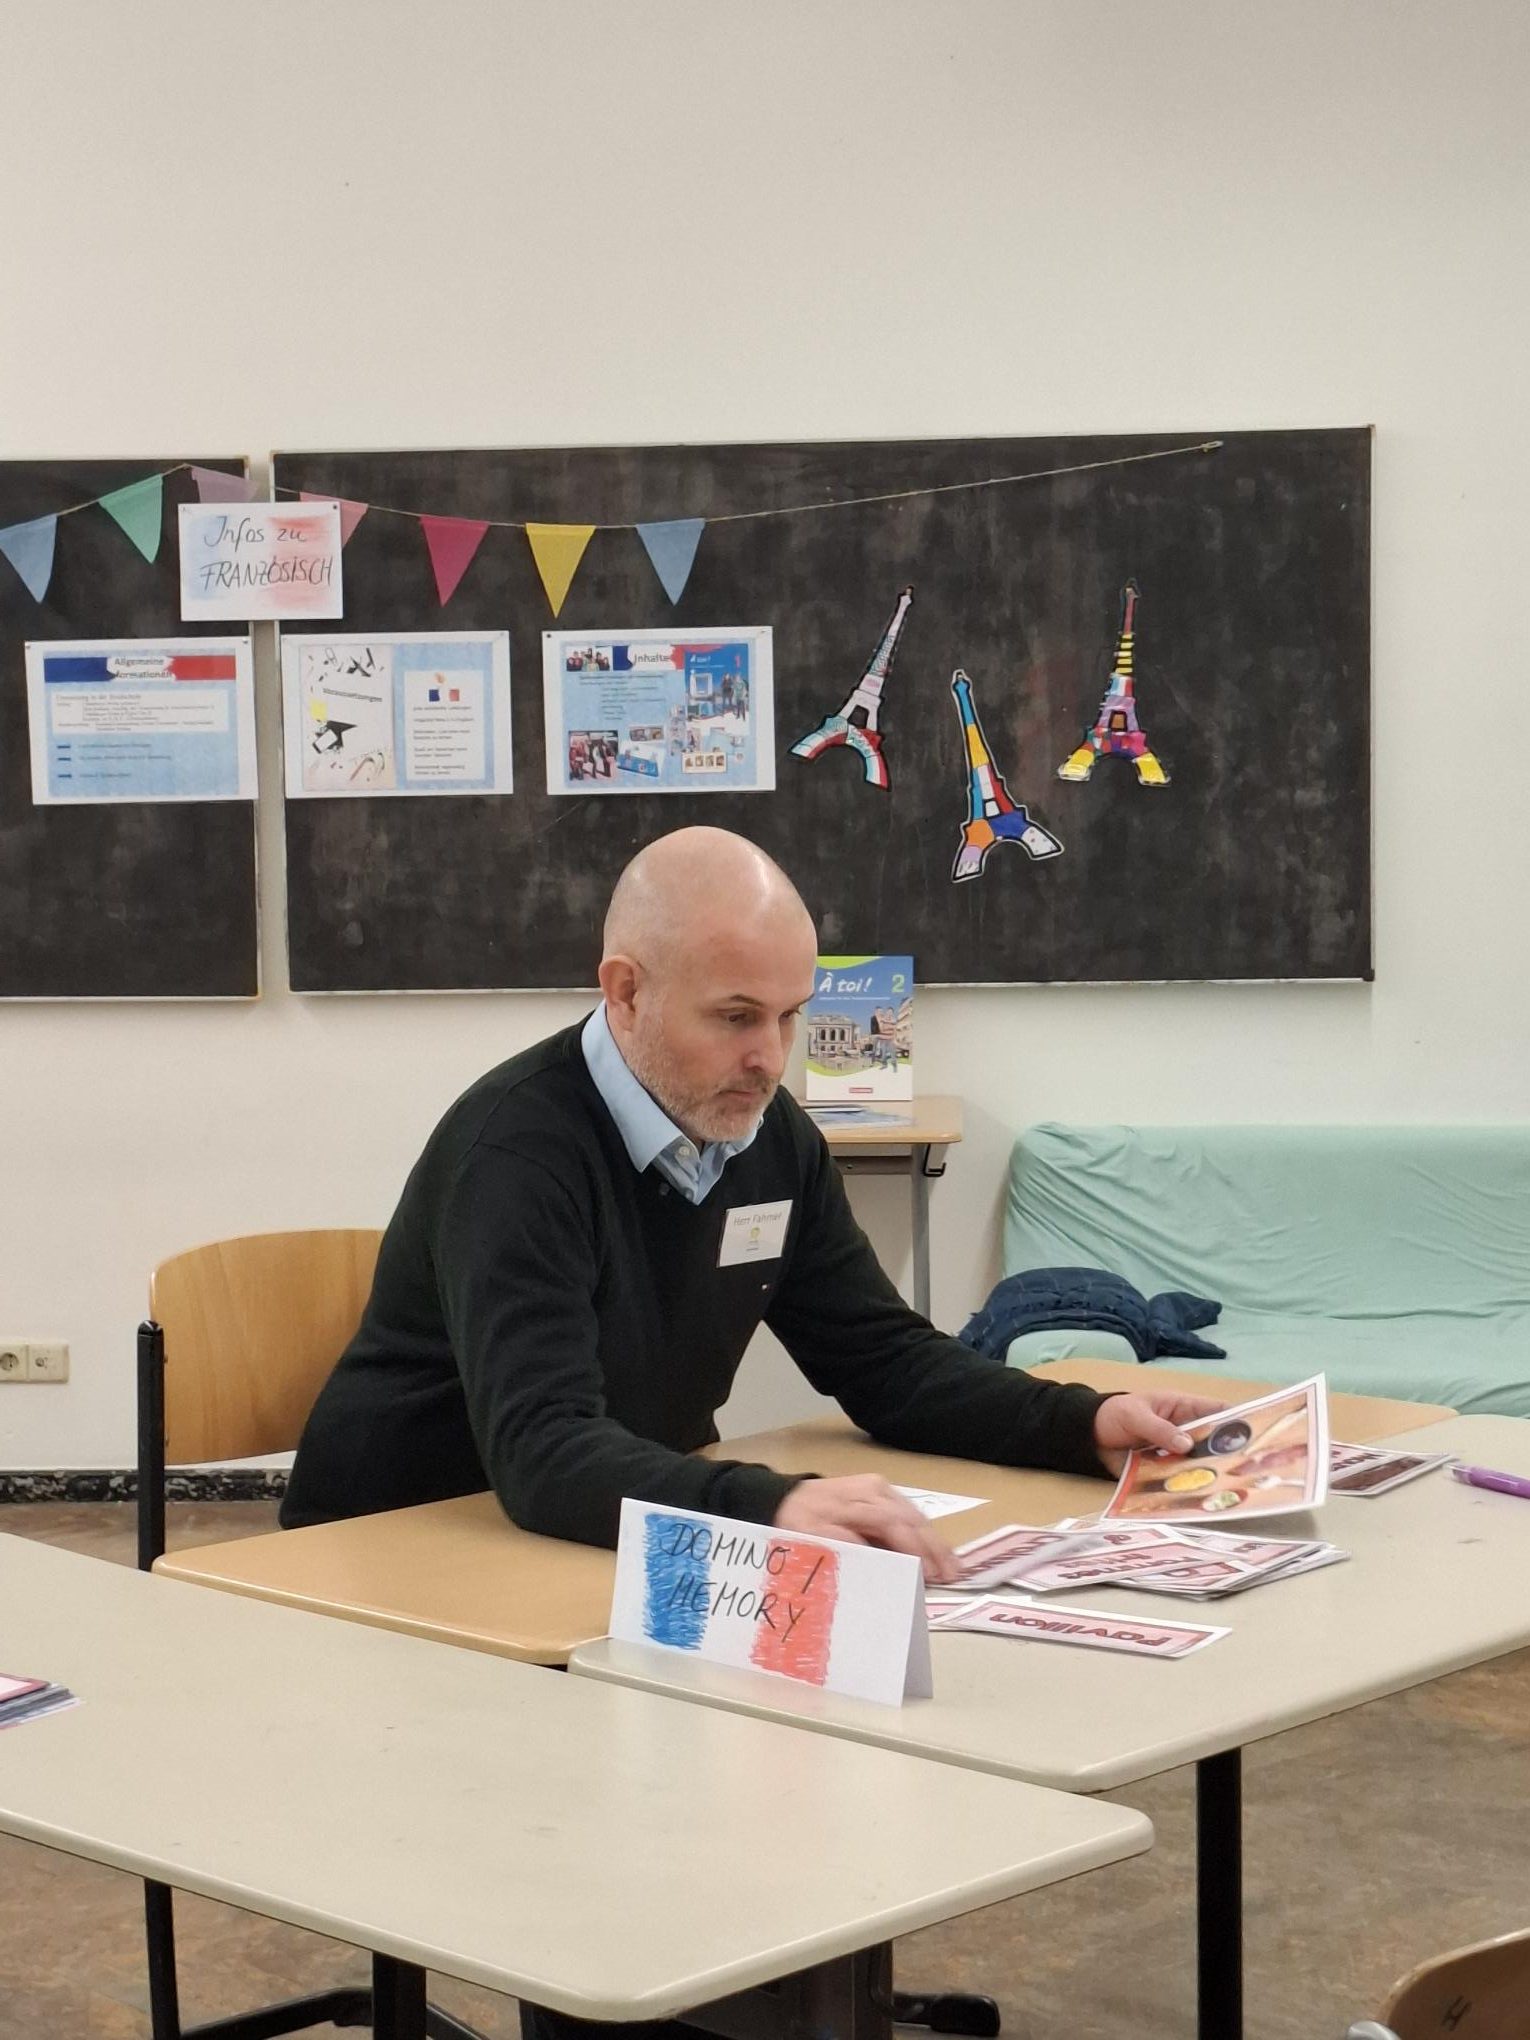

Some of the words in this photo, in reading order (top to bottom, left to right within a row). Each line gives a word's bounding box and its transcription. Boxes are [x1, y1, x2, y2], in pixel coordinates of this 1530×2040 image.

[204, 515, 265, 552] Infos
[277, 528, 307, 542] zu
[819, 971, 834, 992] À
[891, 974, 905, 993] 2
[660, 1522, 791, 1575] DOMINO
[668, 1574, 806, 1643] MEMORY
